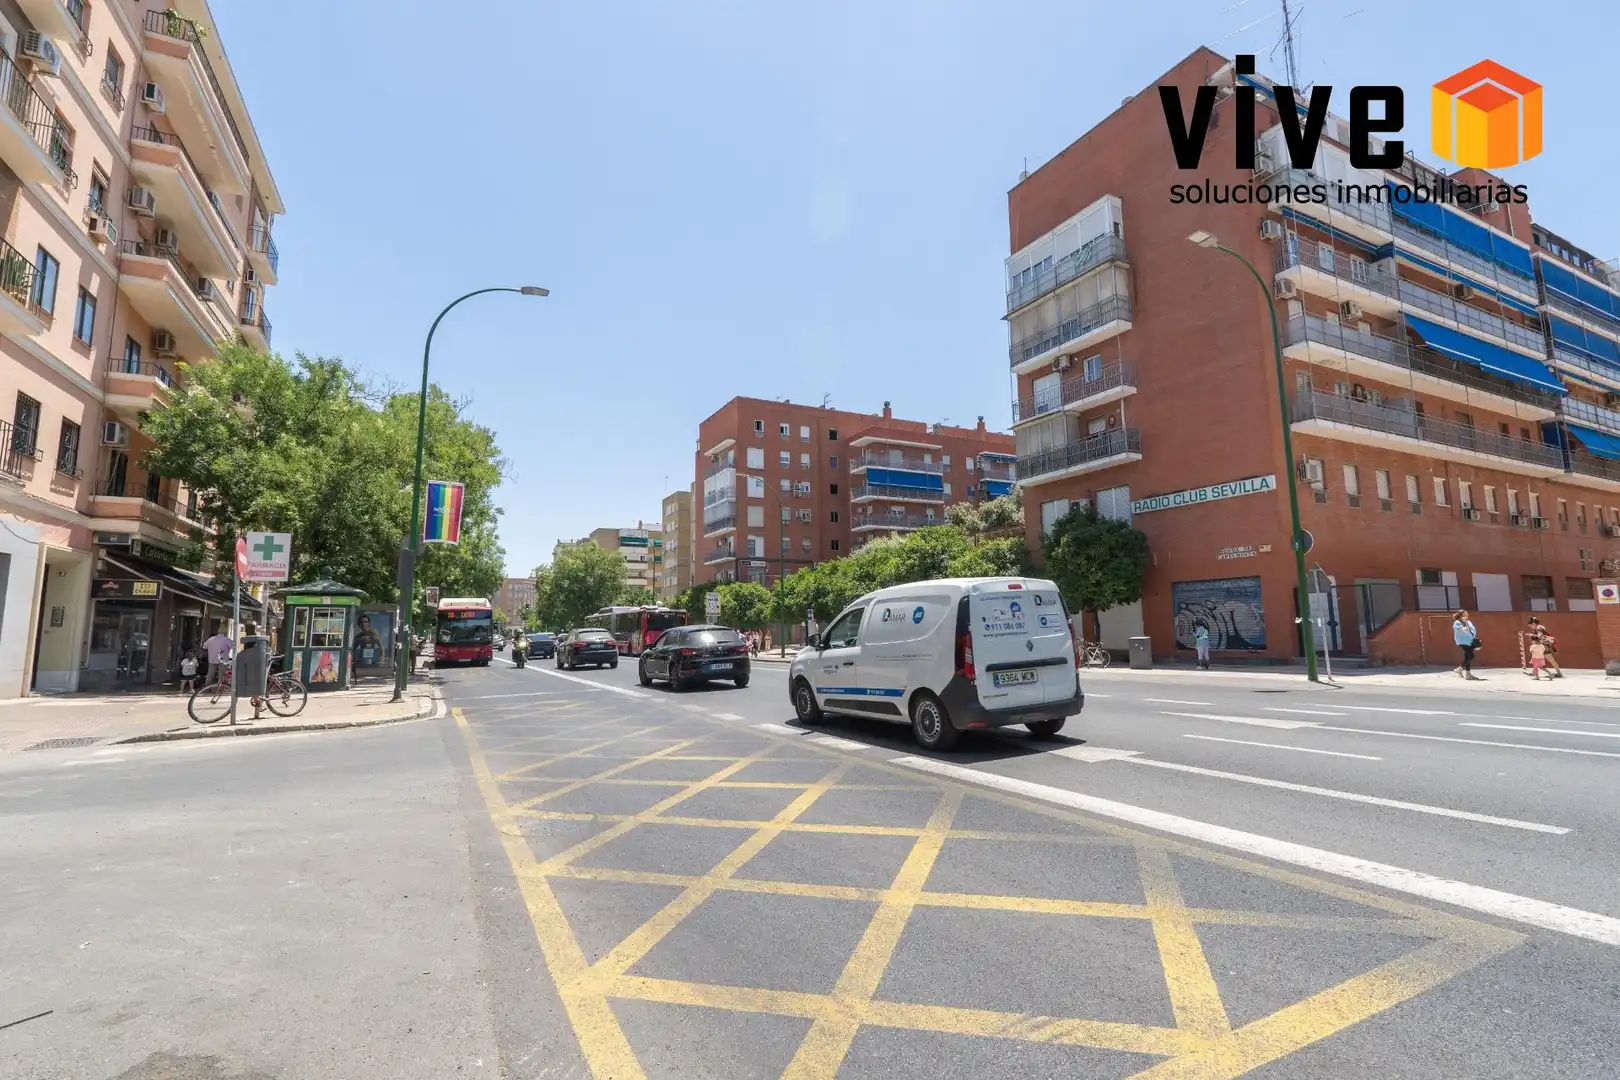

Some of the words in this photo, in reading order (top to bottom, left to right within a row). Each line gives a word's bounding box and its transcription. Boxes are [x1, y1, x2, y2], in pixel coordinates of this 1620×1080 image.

[1134, 496, 1170, 513] RADIO
[1173, 489, 1208, 506] CLUB
[1211, 477, 1270, 499] SEVILLA
[247, 561, 288, 569] FARMACIA
